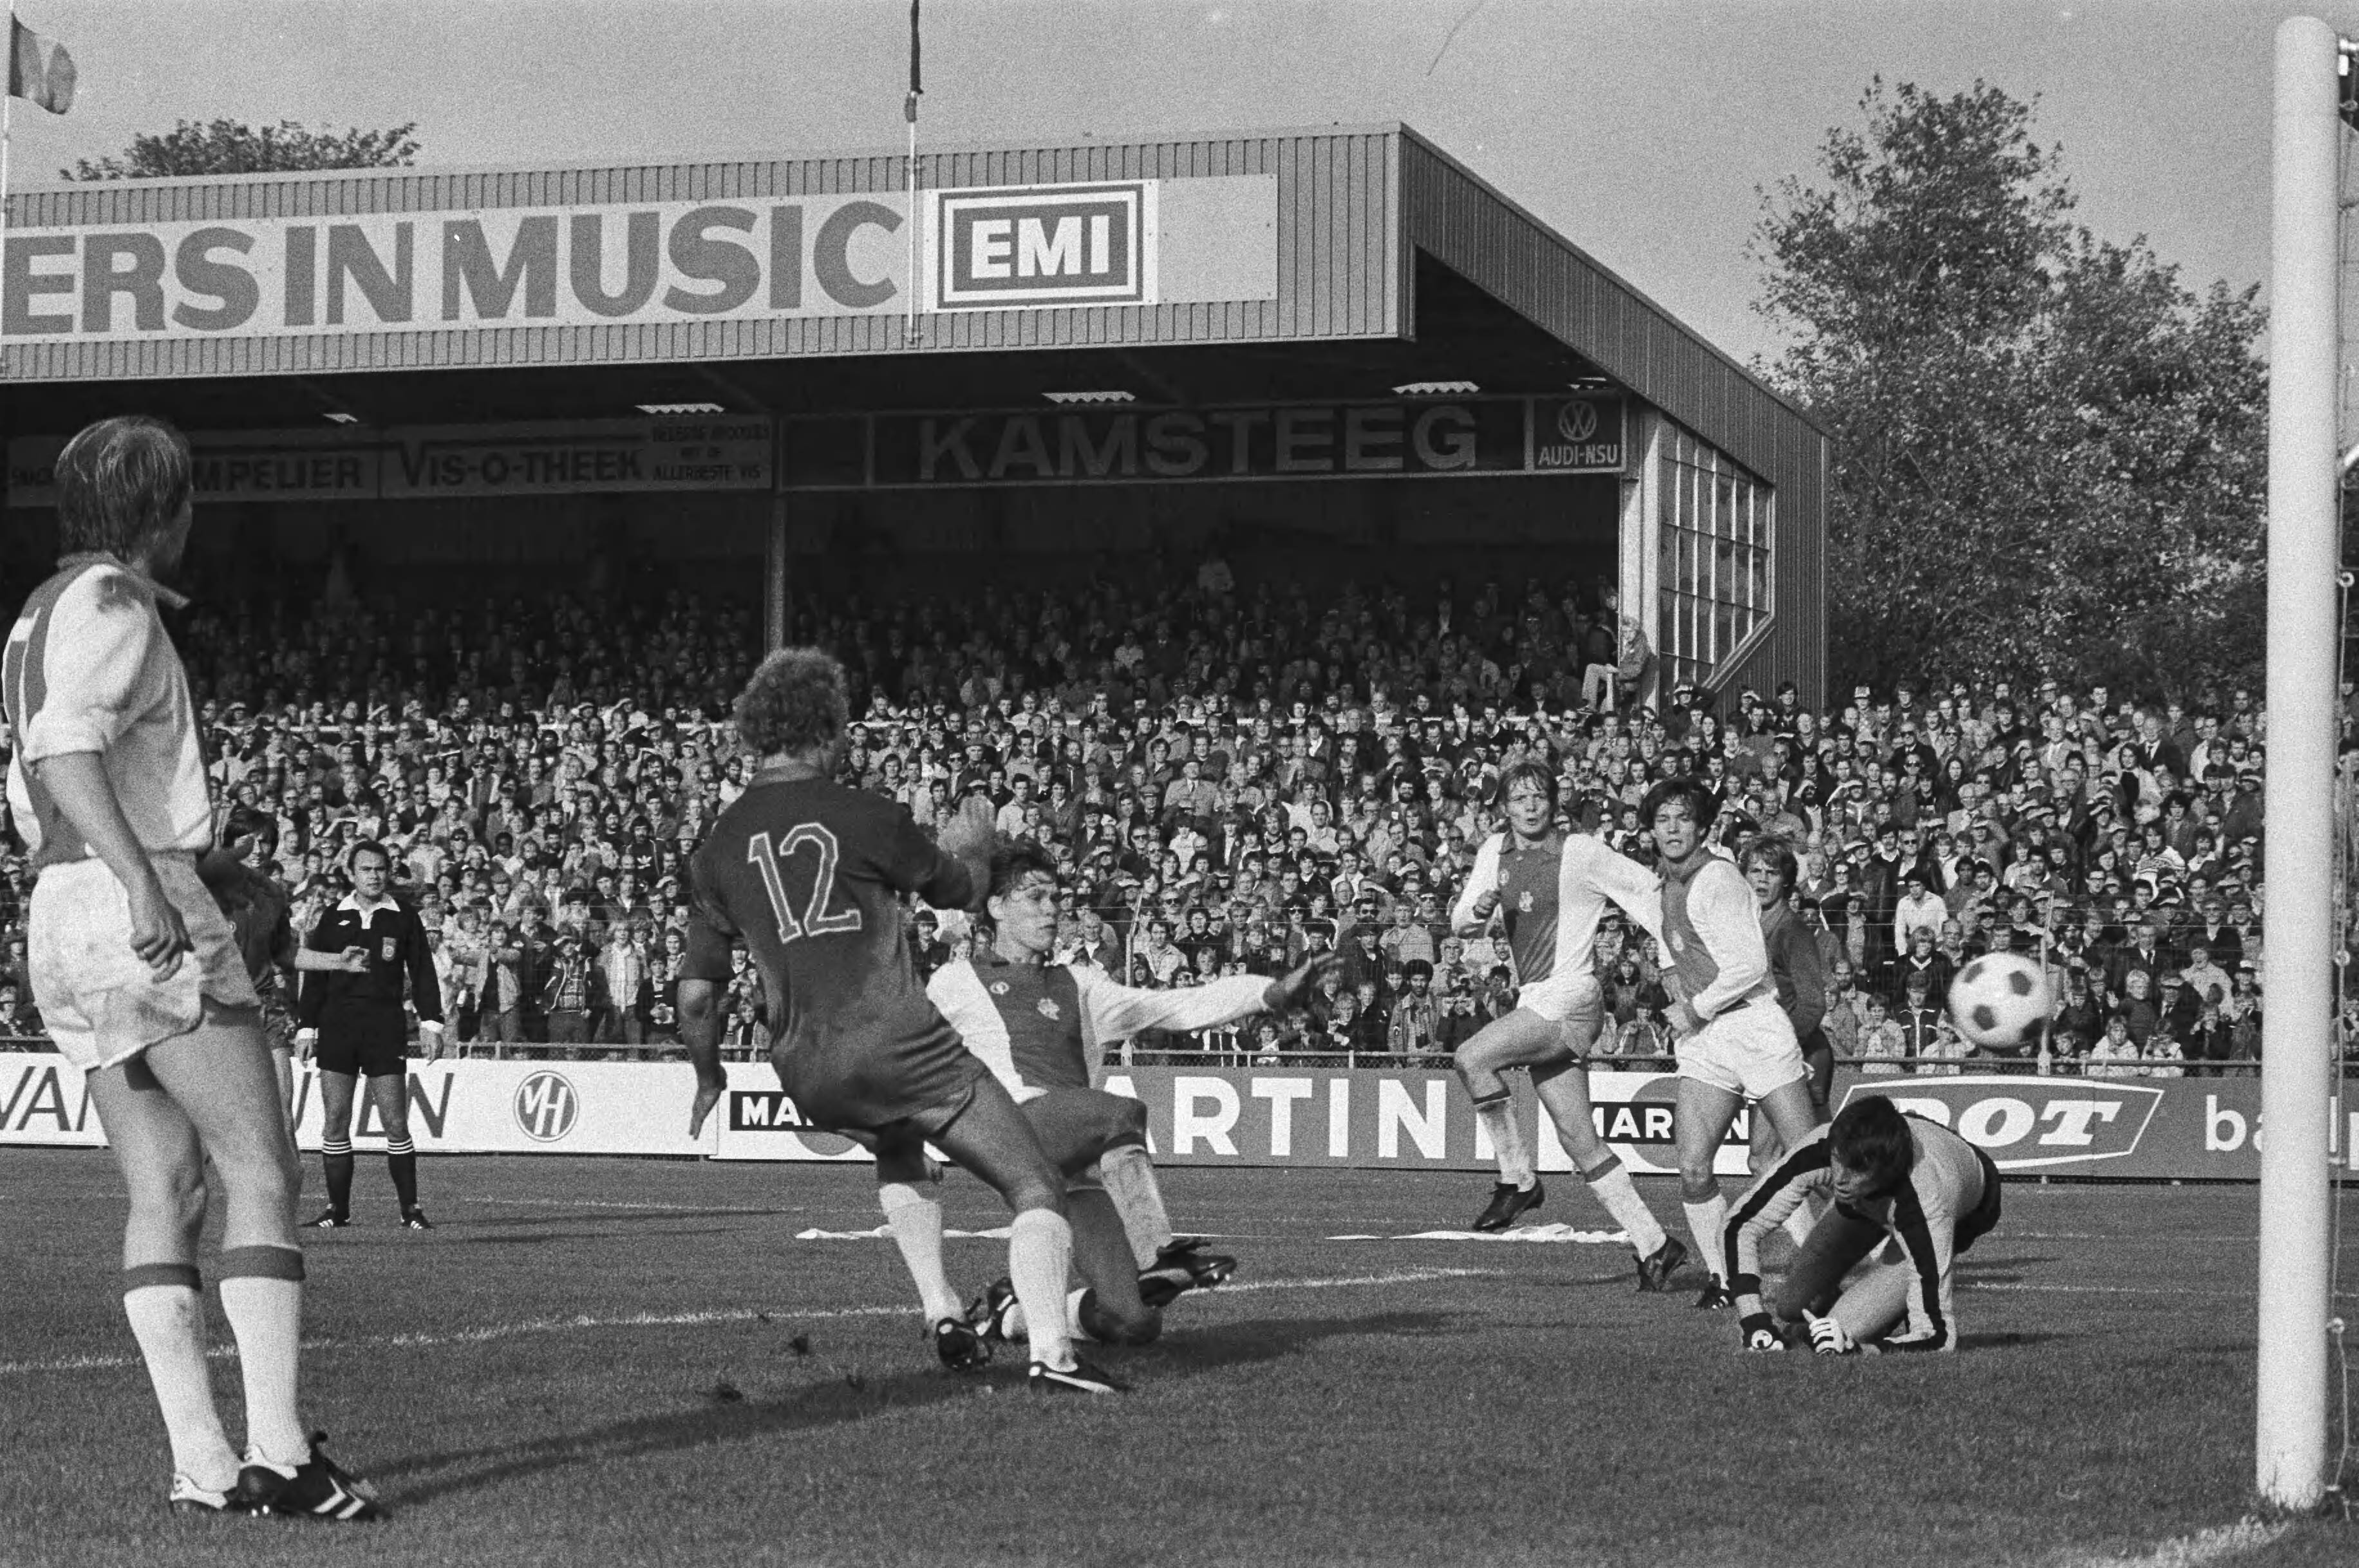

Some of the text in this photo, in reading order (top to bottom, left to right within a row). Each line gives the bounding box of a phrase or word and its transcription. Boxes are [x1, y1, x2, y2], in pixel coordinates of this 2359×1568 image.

[3, 200, 903, 335] ERS IN MUSIC
[971, 214, 1110, 279] EMI
[399, 440, 644, 487] VIS-O-THEEK
[918, 405, 1476, 480] KAMSTEEG
[1537, 444, 1618, 466] AUDI-NSU
[747, 822, 862, 944] 12
